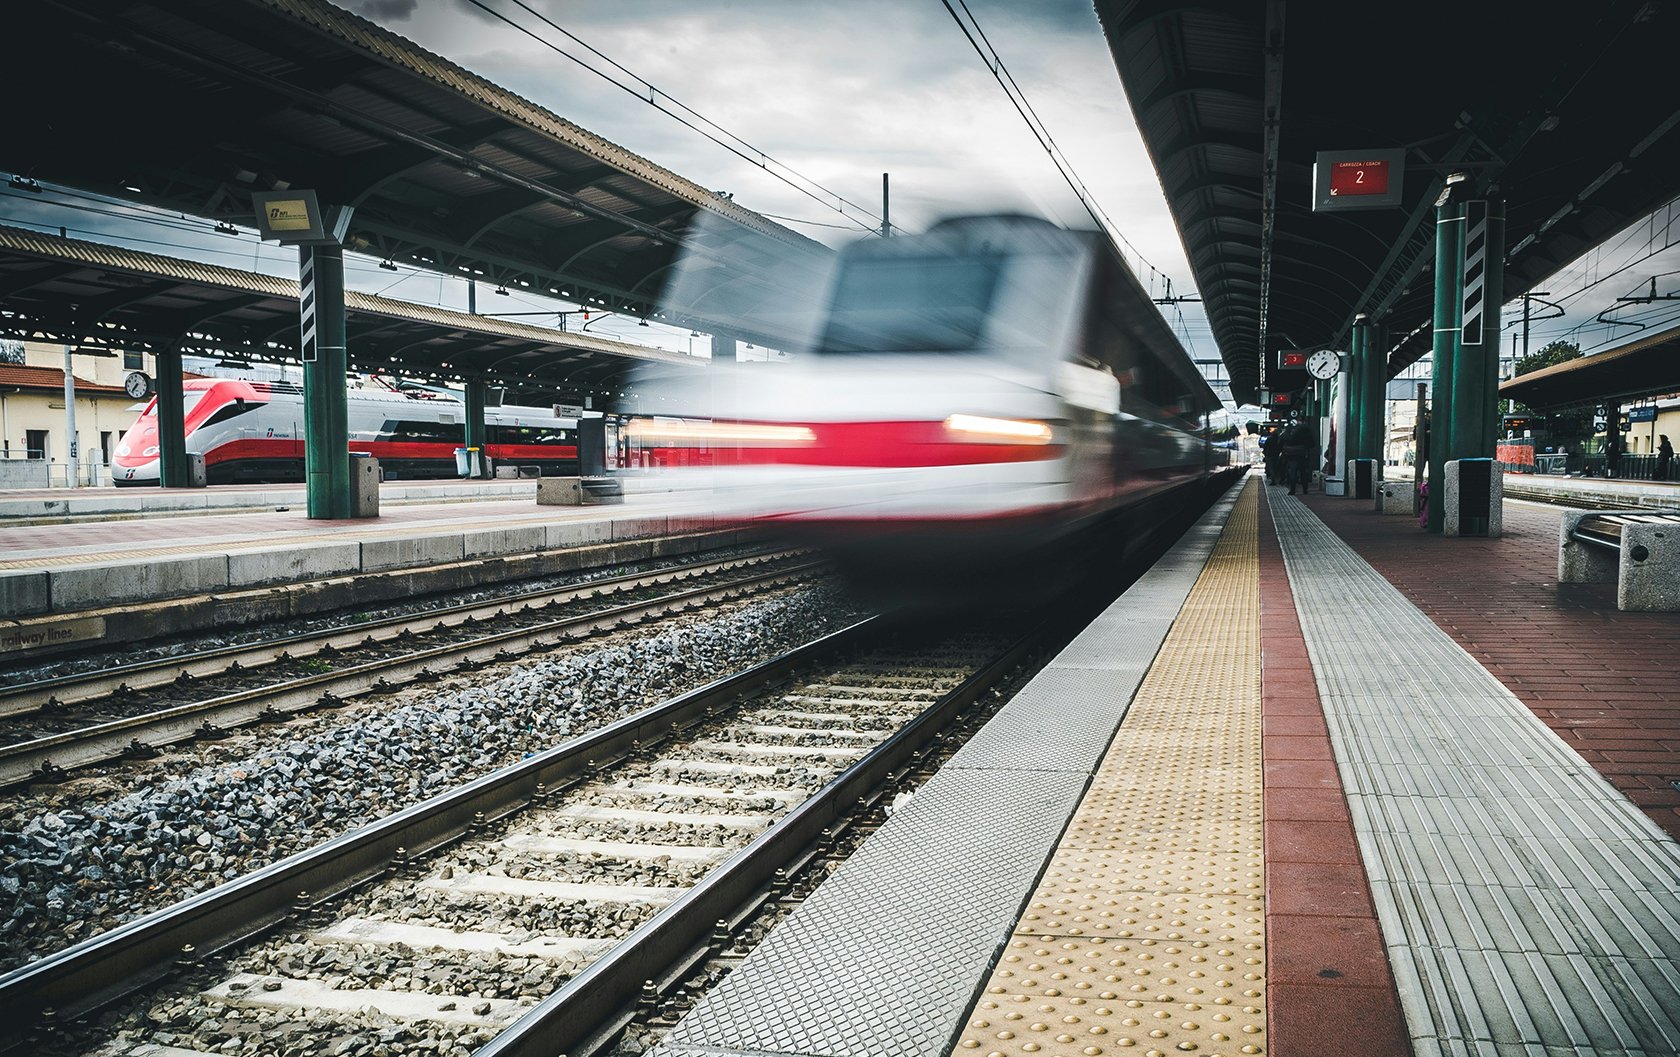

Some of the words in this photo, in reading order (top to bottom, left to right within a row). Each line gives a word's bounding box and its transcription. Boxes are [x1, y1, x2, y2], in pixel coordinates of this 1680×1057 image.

[1356, 171, 1364, 184] 2
[0, 632, 46, 646] railway
[48, 628, 72, 640] lines
